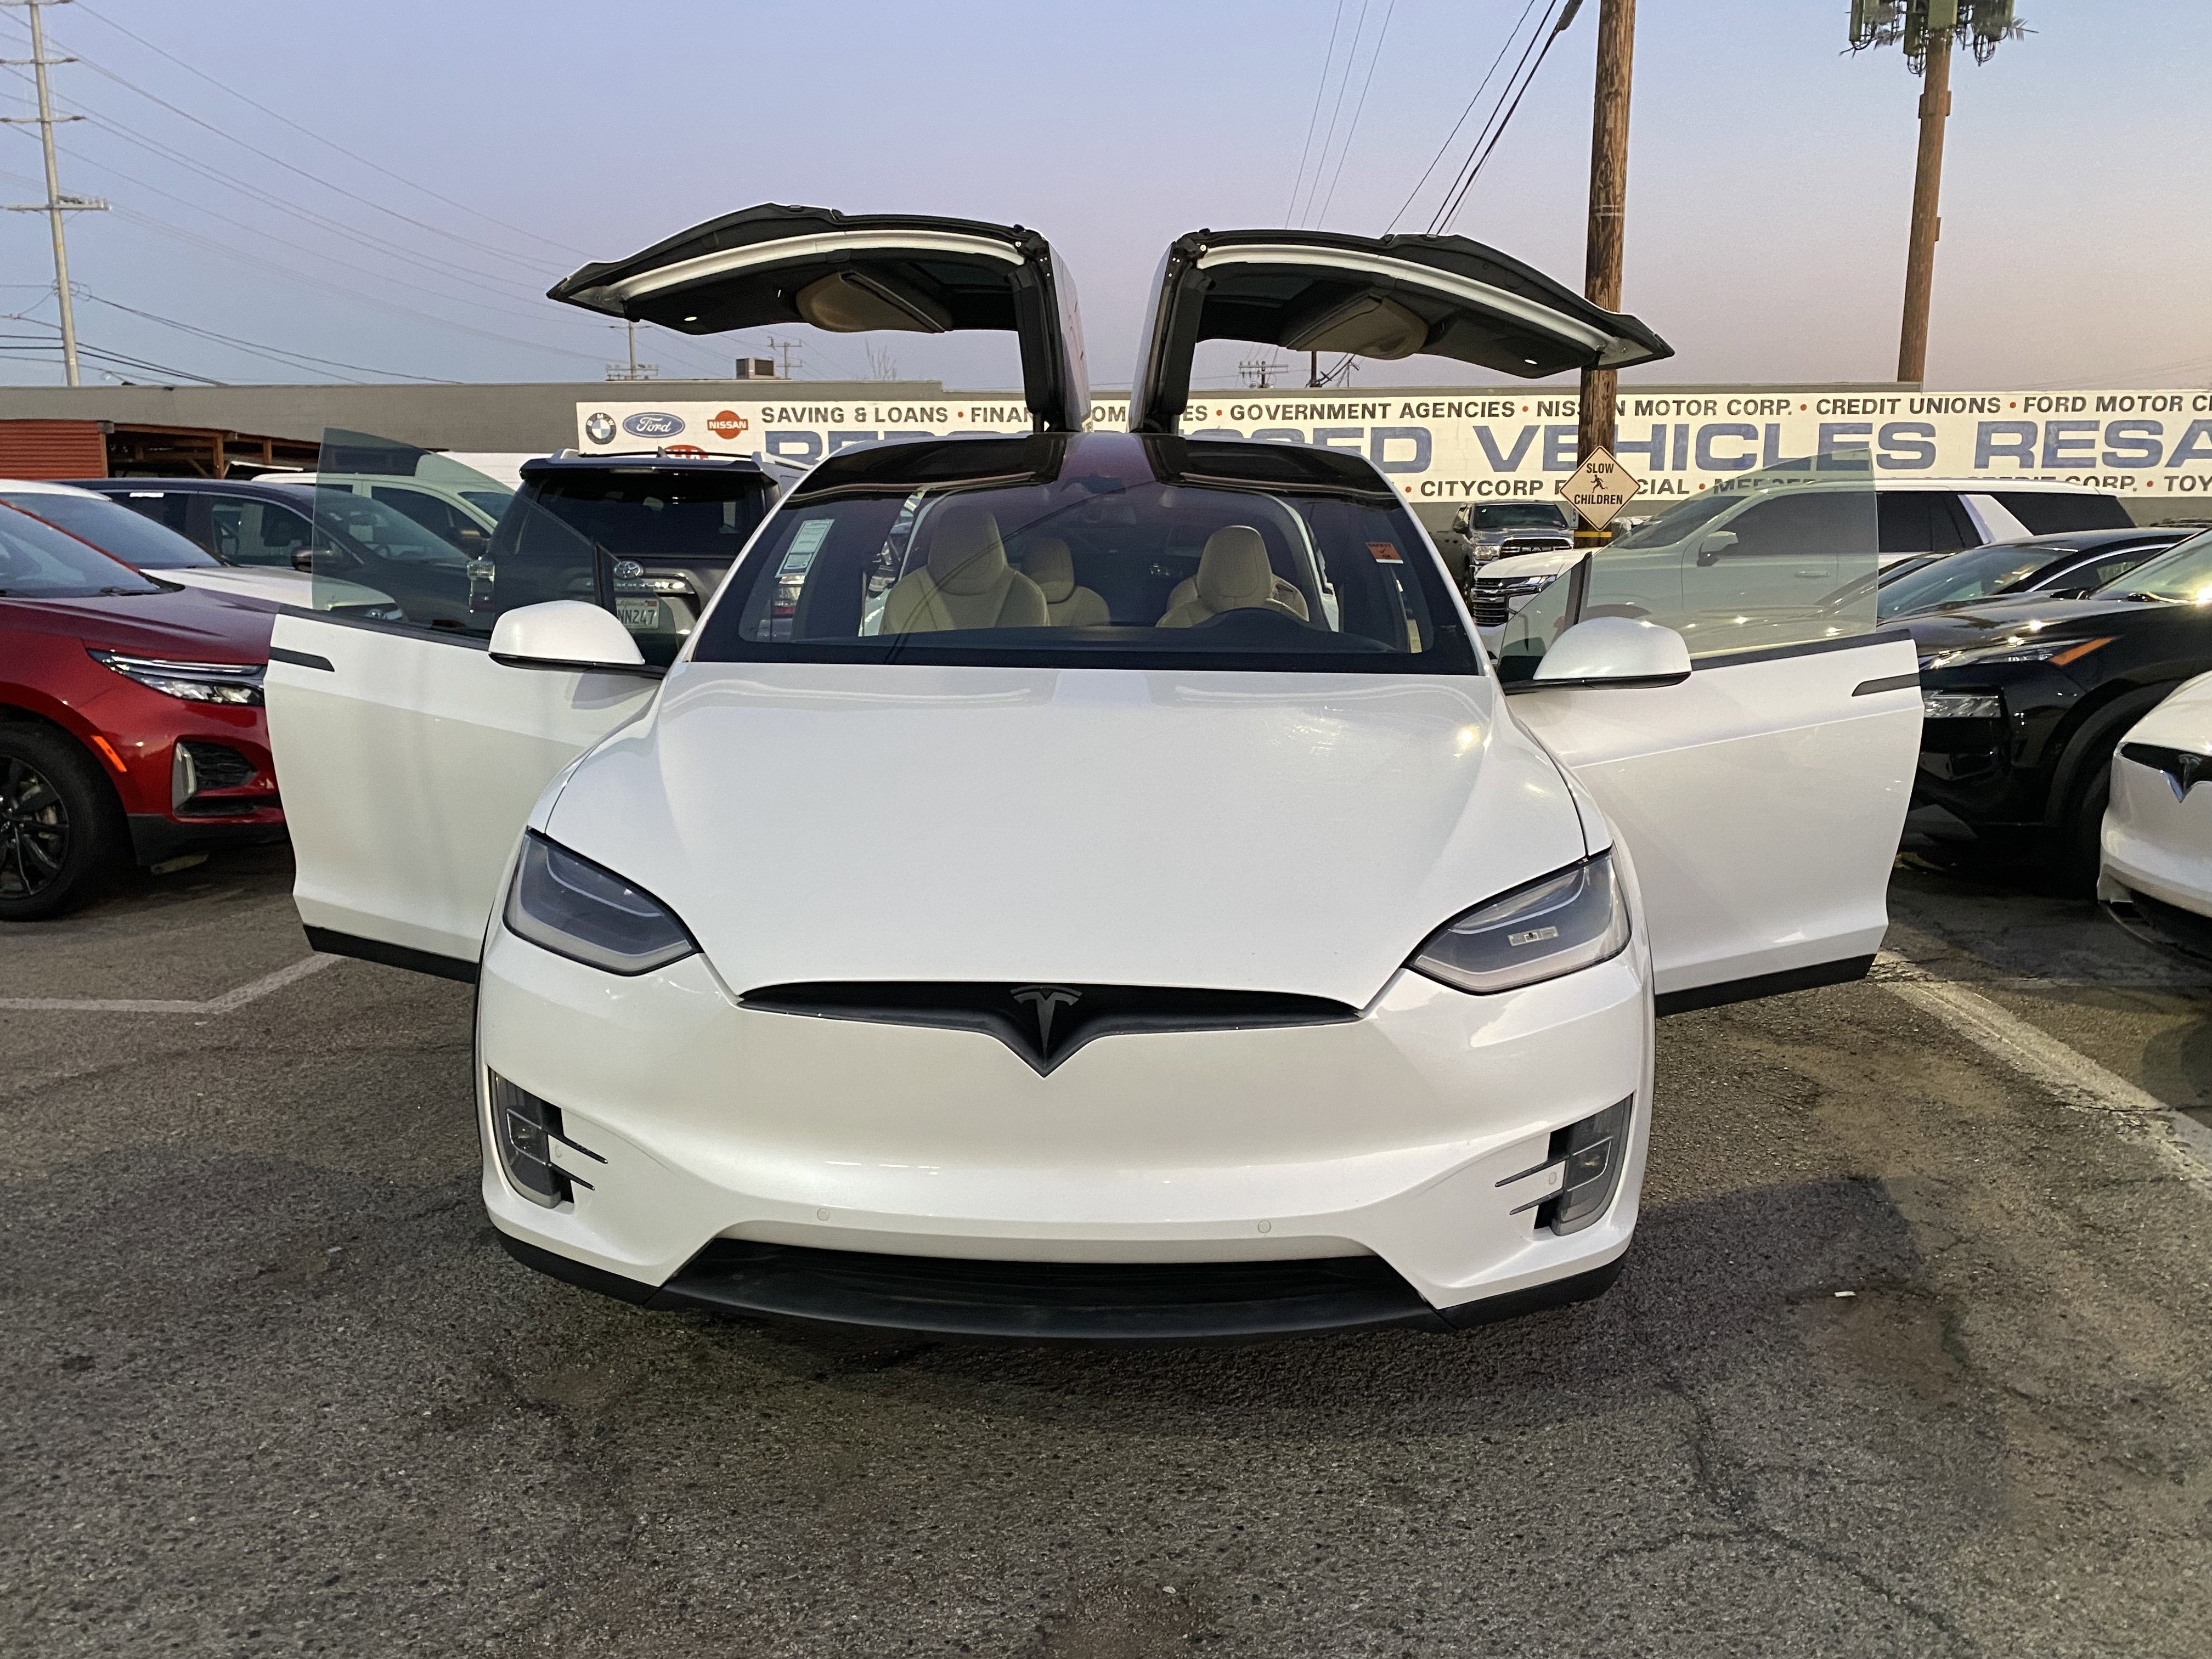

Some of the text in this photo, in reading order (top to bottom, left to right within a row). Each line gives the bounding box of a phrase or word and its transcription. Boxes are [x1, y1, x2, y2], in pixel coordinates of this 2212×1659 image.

[1230, 401, 1516, 421] GOVERNMENT AGENCIES
[1537, 399, 1792, 417] NISN MOTOR CORP.
[1816, 397, 2002, 415] CREDIT UNIONS
[2023, 395, 2212, 413] FORD MOTOR C
[761, 407, 844, 423] SAVING
[854, 407, 867, 422] &
[874, 407, 949, 423] LOANS
[636, 417, 672, 432] Ford
[709, 421, 747, 430] NISSAN
[1472, 421, 1937, 472] VEHICLES
[1586, 462, 1615, 474] SLOW
[1420, 479, 1544, 497] CITYCORP
[1573, 494, 1623, 505] CHILDREN
